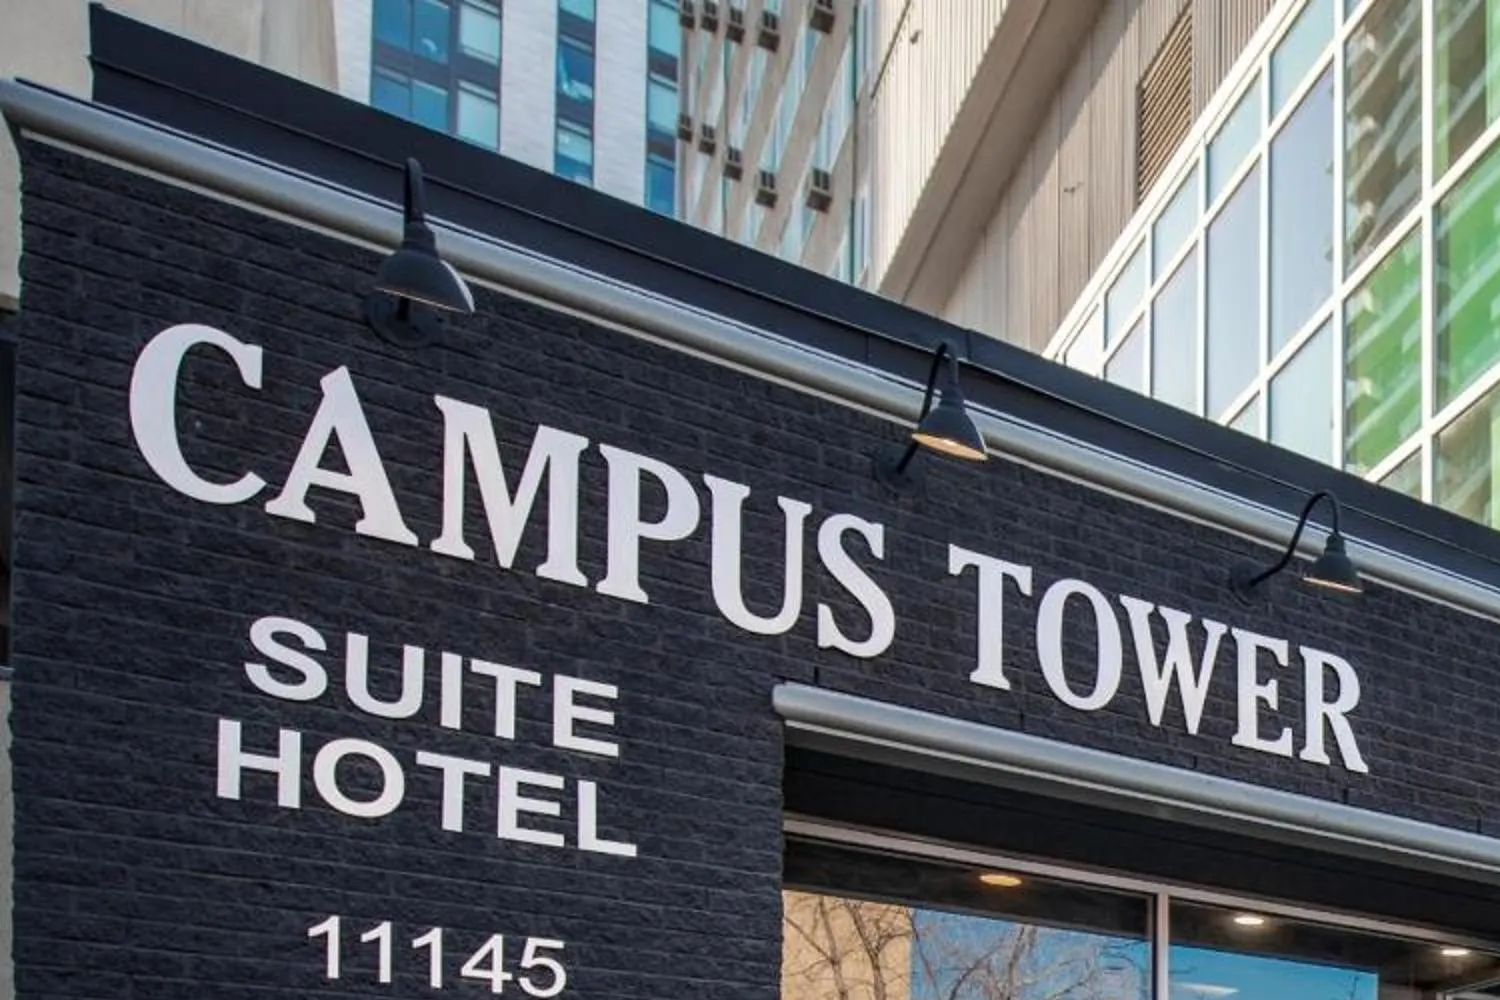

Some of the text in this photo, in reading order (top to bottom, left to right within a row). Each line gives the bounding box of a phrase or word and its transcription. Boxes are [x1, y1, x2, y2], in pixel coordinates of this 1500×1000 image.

[129, 322, 1369, 774] CAMPUS TOWER
[244, 615, 619, 757] SUITE
[216, 717, 637, 857] HOTEL
[307, 914, 567, 998] 11145
